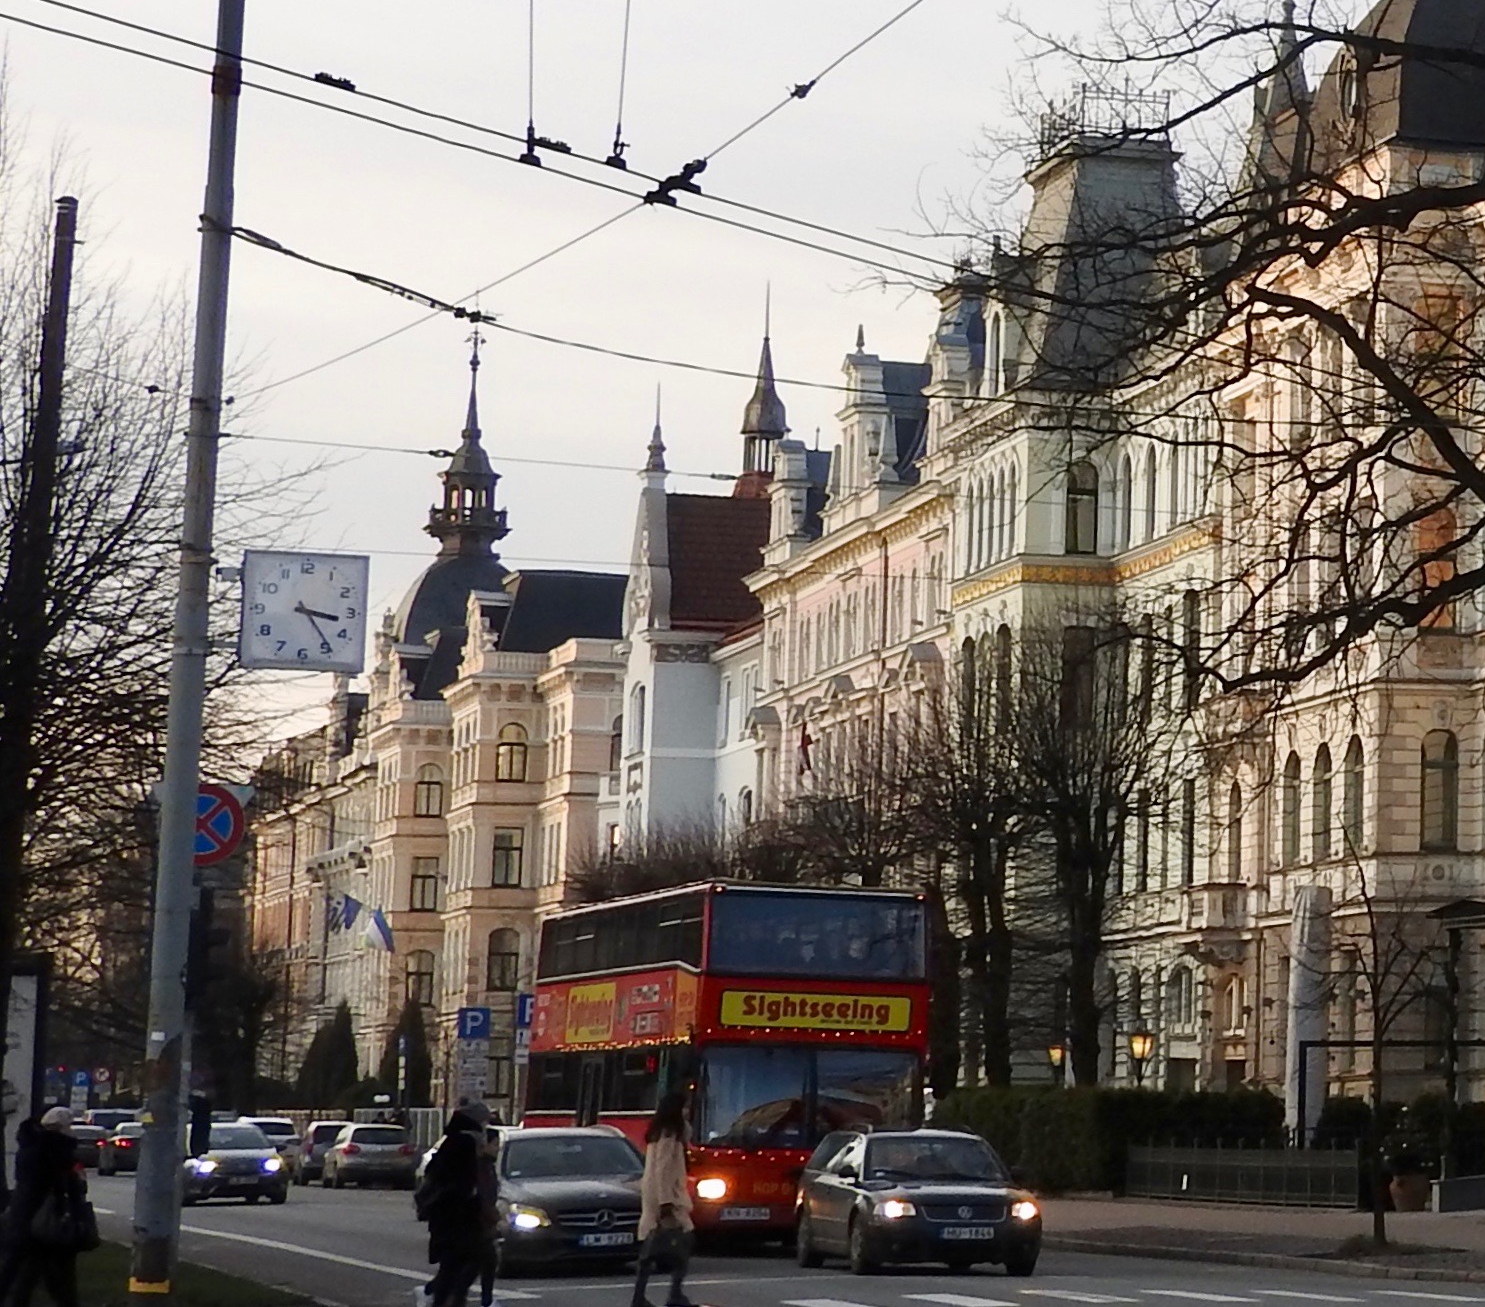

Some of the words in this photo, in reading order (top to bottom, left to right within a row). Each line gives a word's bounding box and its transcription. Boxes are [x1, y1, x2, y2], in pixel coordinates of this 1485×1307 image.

[300, 562, 315, 574] 12
[281, 569, 290, 580] 11
[329, 571, 334, 581] 1
[262, 582, 278, 594] 10
[340, 586, 350, 598] 2
[255, 603, 265, 614] 9
[346, 607, 356, 619] 3
[260, 624, 271, 636] 8
[337, 629, 347, 639] 4
[276, 640, 287, 651] 7
[297, 648, 308, 660] 6
[742, 994, 891, 1025] Sightseeing
[466, 1011, 484, 1035] P
